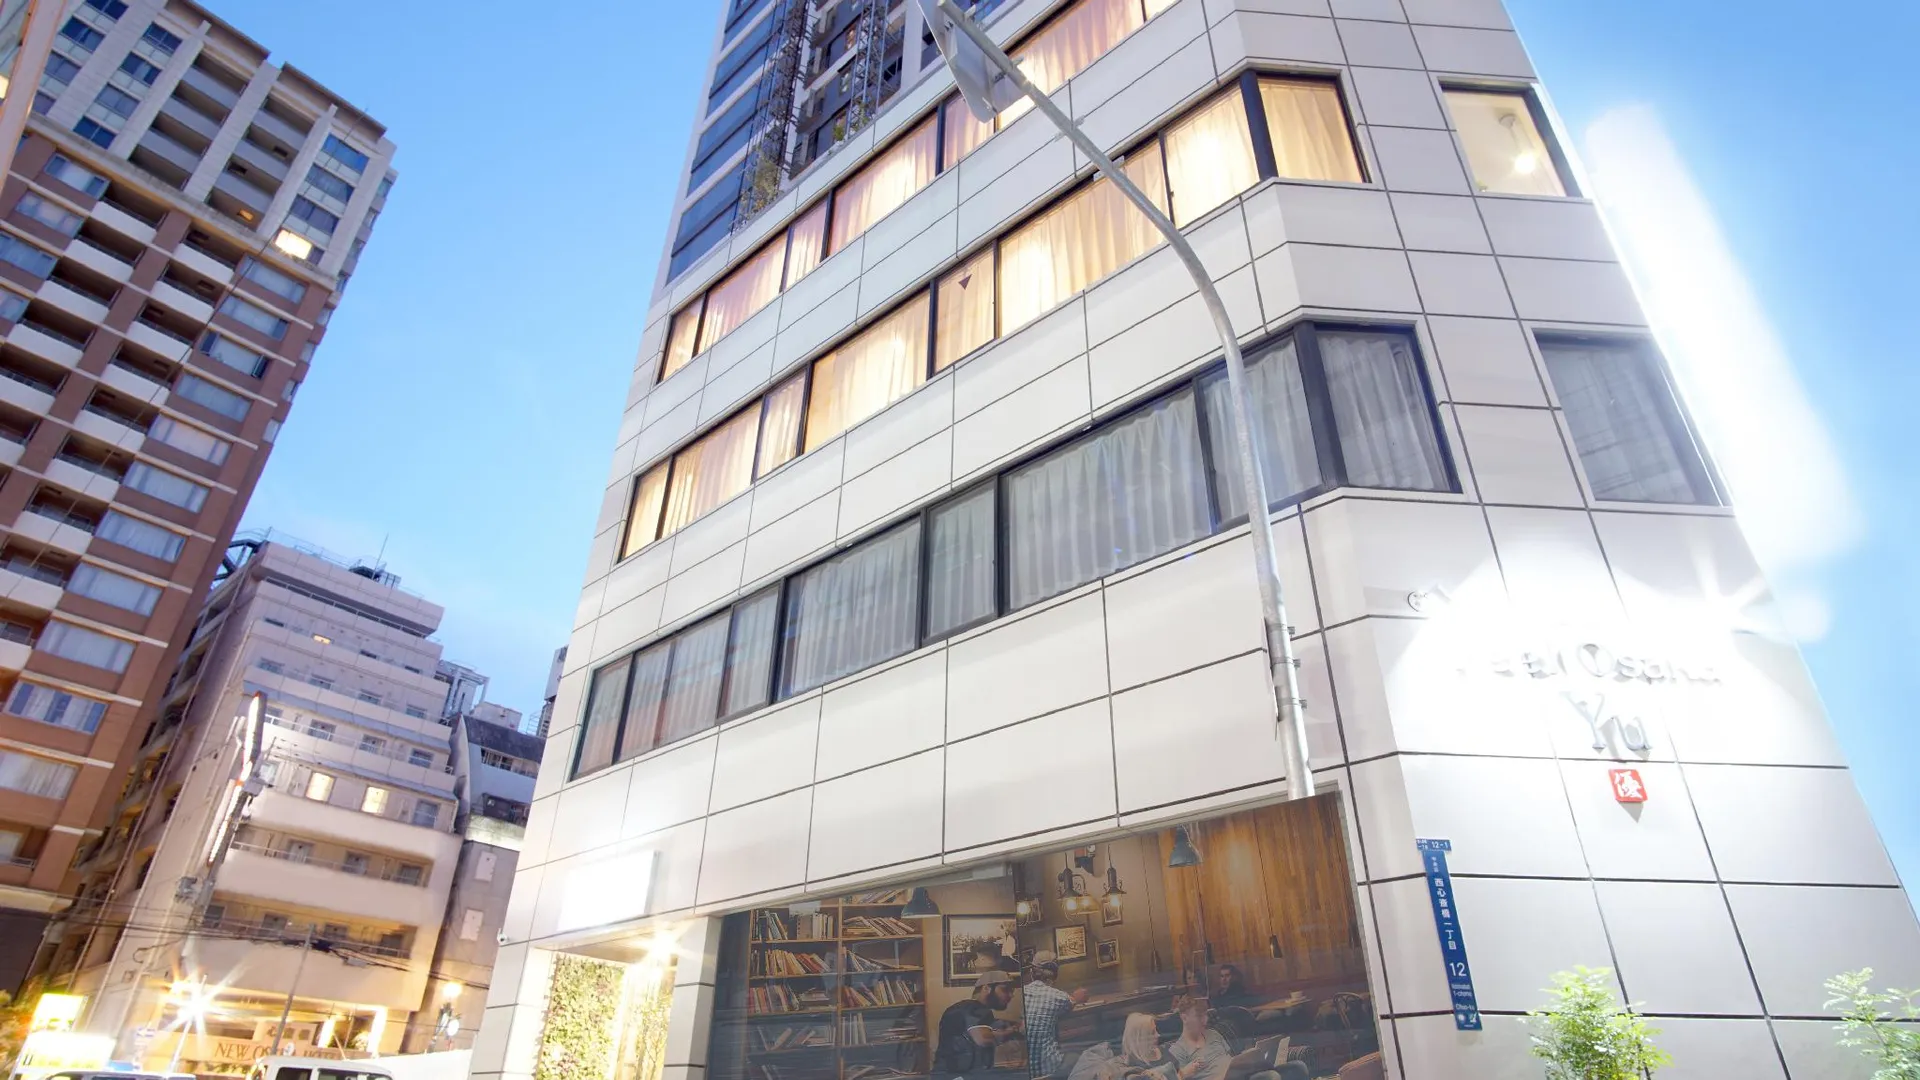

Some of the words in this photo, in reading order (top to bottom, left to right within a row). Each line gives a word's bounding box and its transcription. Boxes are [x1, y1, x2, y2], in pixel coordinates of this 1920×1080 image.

[1558, 690, 1653, 753] Yu
[1428, 840, 1448, 849] 12-1
[1449, 962, 1467, 977] 12
[215, 1042, 250, 1060] NEW
